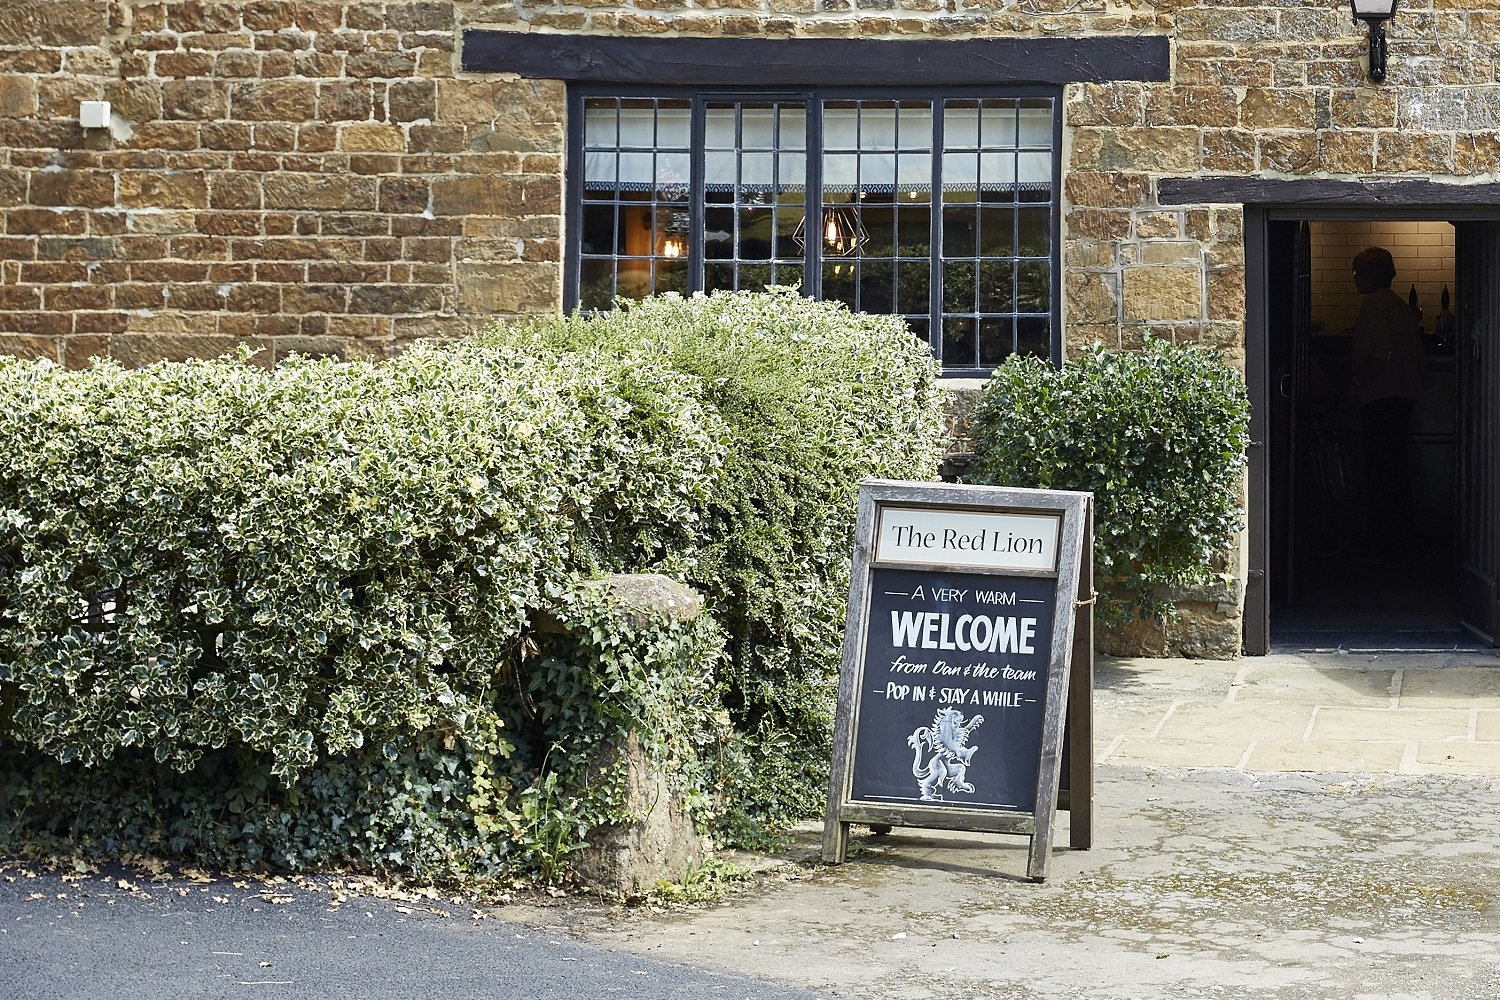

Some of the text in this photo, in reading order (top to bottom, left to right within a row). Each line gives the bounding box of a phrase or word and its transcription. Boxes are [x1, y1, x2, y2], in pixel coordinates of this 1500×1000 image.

[892, 525, 1044, 554] The Red Lion
[911, 585, 1016, 605] A VERY WARM
[891, 610, 1037, 654] WELCOME
[889, 655, 1036, 681] from Dan & the team
[886, 681, 1023, 707] POP IN & STAY A WHILE
